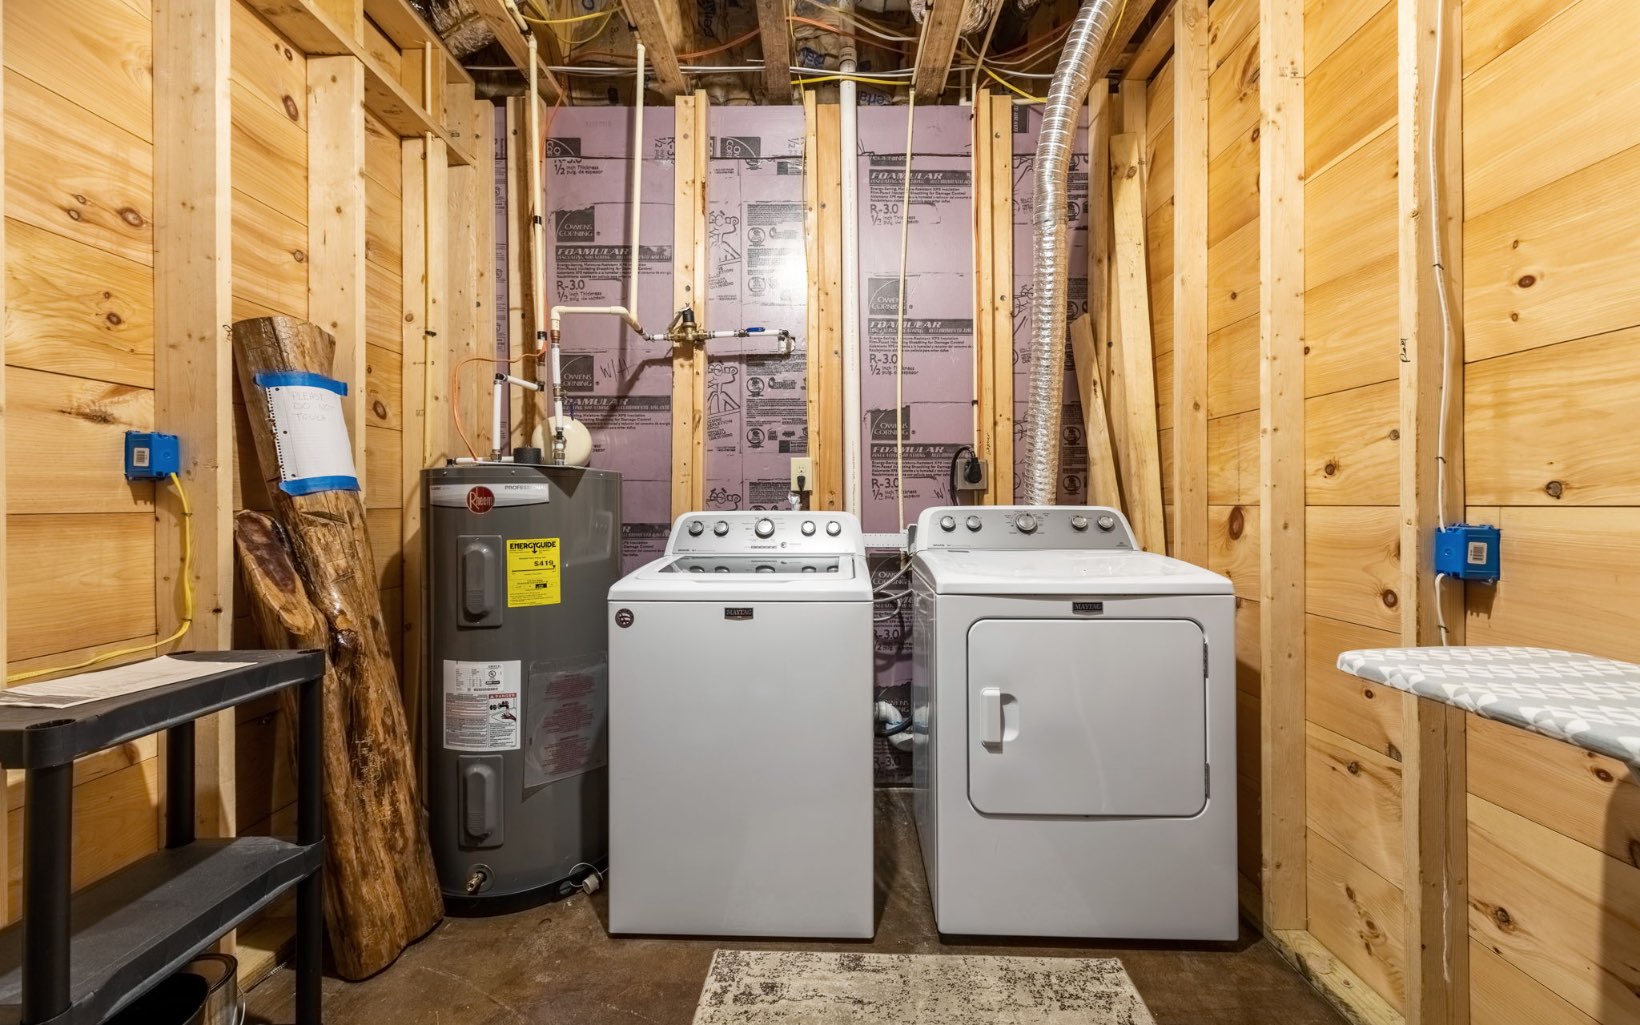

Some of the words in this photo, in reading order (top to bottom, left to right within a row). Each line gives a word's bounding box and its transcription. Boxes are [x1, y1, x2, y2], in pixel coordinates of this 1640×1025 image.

[870, 203, 899, 215] R-3.0
[556, 279, 585, 291] R-3.0
[469, 487, 493, 511] Rheem
